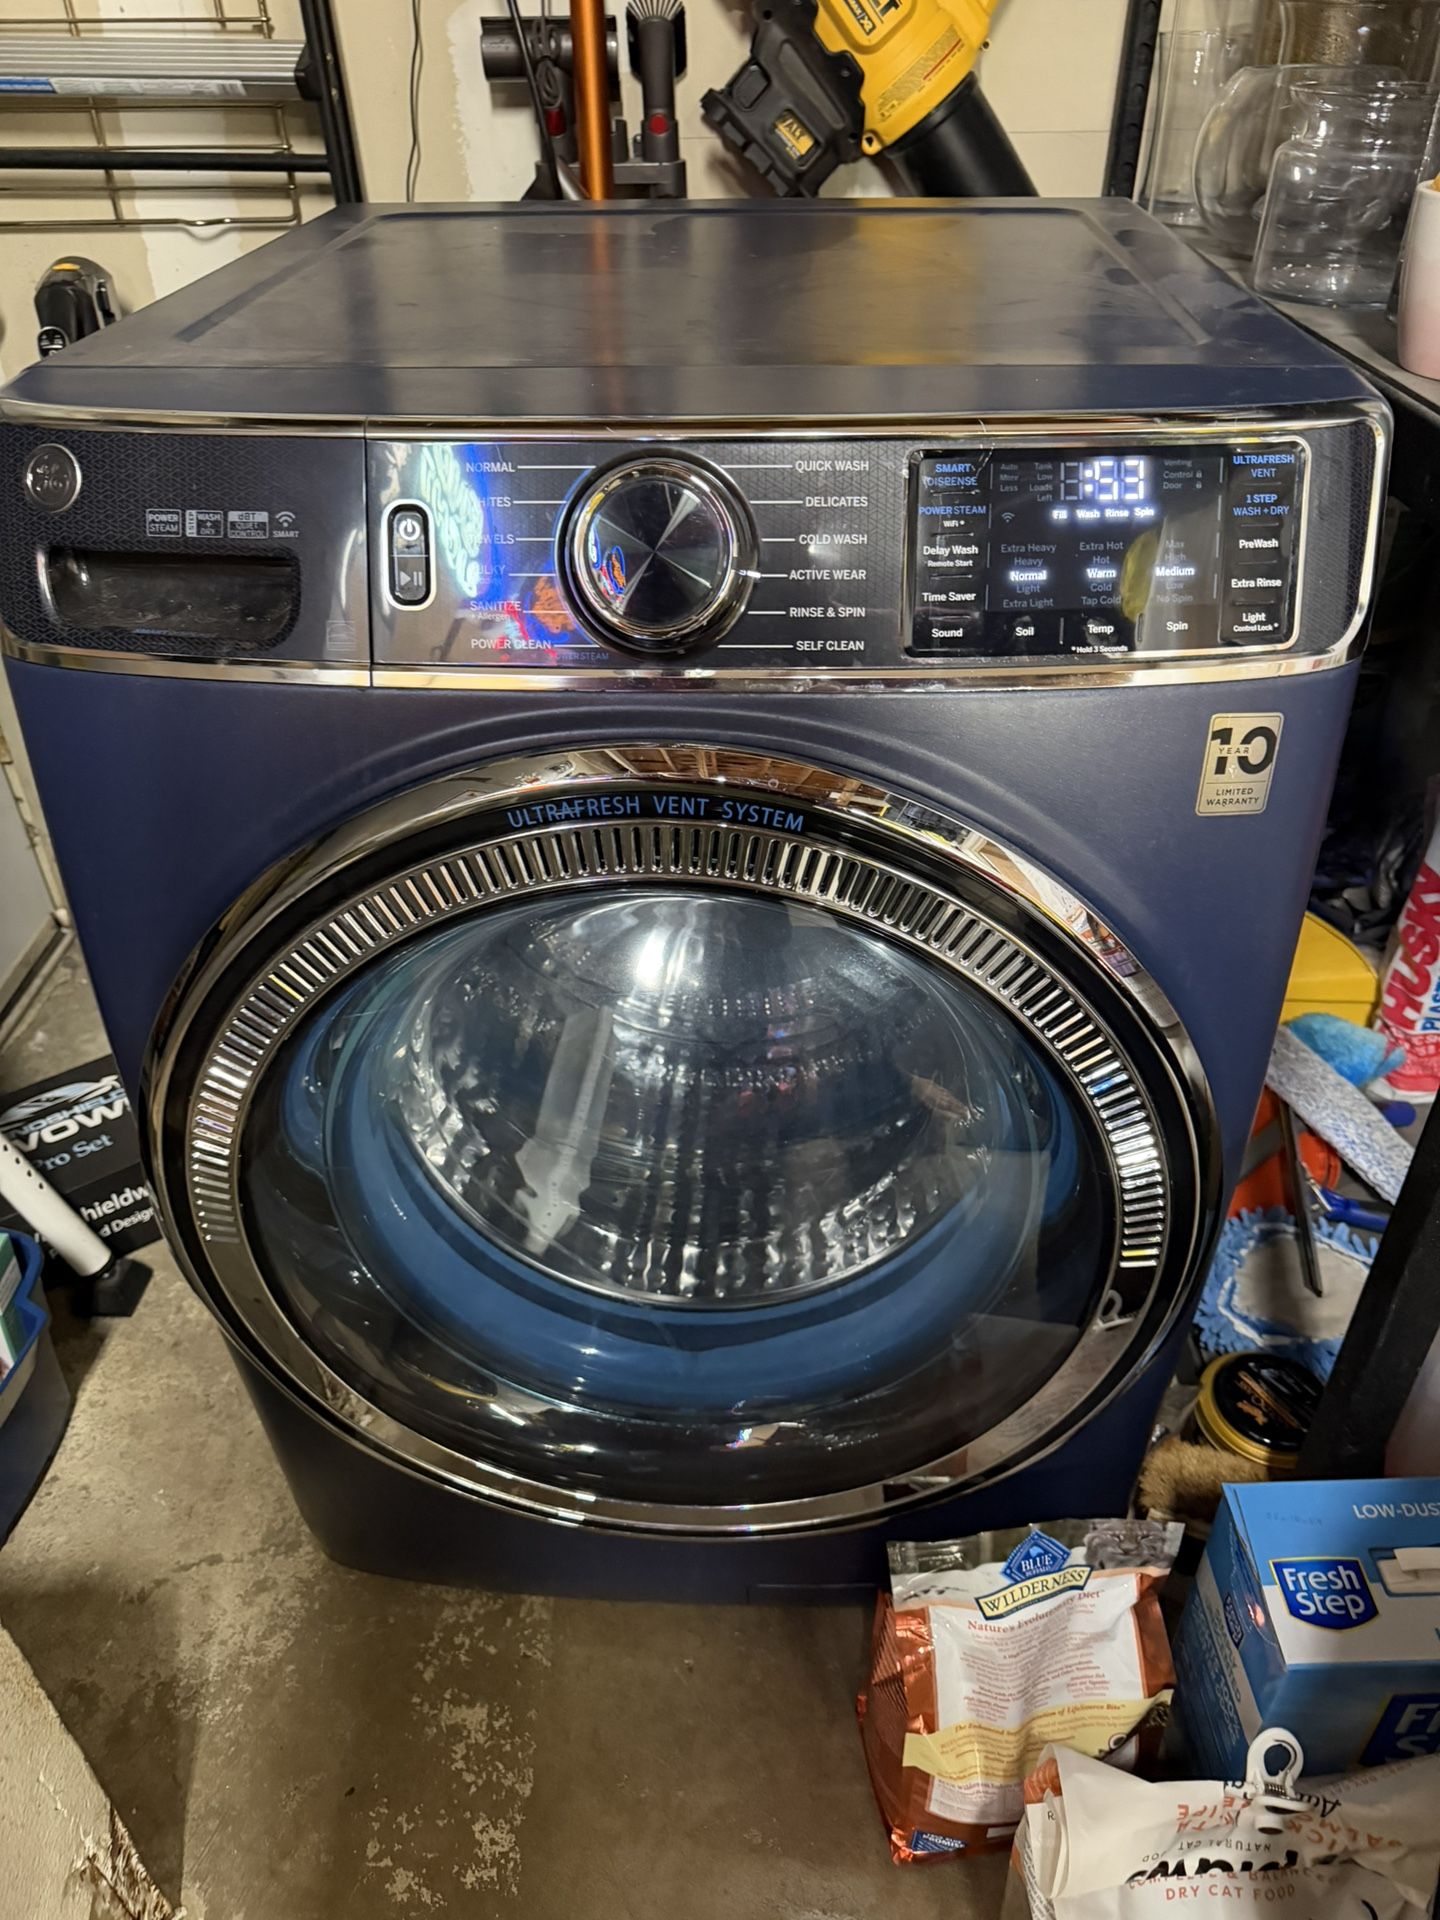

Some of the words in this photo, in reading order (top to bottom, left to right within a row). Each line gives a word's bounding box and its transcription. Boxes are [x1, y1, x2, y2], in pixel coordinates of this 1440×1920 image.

[1233, 454, 1295, 465] ULTRAFRESH
[465, 462, 516, 473] NORMAL
[795, 460, 833, 472] QUICK
[834, 460, 870, 472] WASH
[935, 463, 971, 473] SMART
[1037, 473, 1053, 481] Low
[1163, 470, 1193, 479] Control
[1250, 468, 1277, 478] VENT
[927, 476, 978, 486] DISPENSE
[1162, 481, 1183, 489] Door
[999, 484, 1019, 492] Less
[805, 496, 869, 508] DELICATES
[1246, 495, 1251, 503] 1
[1252, 494, 1278, 504] STEP
[1076, 509, 1100, 519] Wash
[1105, 509, 1129, 518] Rinse
[1134, 508, 1155, 519] Spin
[1233, 507, 1261, 516] WASH
[1270, 506, 1290, 516] DRY
[148, 514, 179, 523] POWER
[149, 523, 178, 532] STEAM
[798, 534, 832, 545] COLD
[833, 534, 868, 545] WASH
[1239, 539, 1279, 549] PreWash
[923, 545, 950, 557] Delay
[952, 544, 979, 555] Wash
[1000, 543, 1027, 553] Extra
[1028, 543, 1057, 554] Heavy
[1079, 541, 1104, 551] Extra
[1106, 541, 1124, 550] Hot
[927, 559, 954, 567] Remote
[955, 559, 973, 567] Start
[1014, 557, 1044, 567] Heavy
[1093, 555, 1110, 565] Hot
[789, 569, 831, 580] ACTIVE
[832, 569, 866, 580] WEAR
[1009, 571, 1048, 582] Normal
[1087, 567, 1117, 579] Warm
[1156, 566, 1195, 577] Medium
[1090, 583, 1113, 592] Cold
[1231, 578, 1255, 588] Extra
[1256, 577, 1282, 587] Rinse
[1016, 584, 1041, 594] Light
[922, 592, 947, 602] Time
[948, 591, 976, 602] Saver
[1081, 595, 1100, 606] Tap
[1100, 595, 1122, 605] Cold
[469, 600, 522, 612] SANITIZE
[1002, 598, 1028, 609] Extra
[1029, 598, 1054, 609] Light
[789, 607, 825, 618] RINSE
[827, 607, 836, 618] &
[838, 607, 866, 618] SPIN
[1242, 612, 1266, 623] Light
[1015, 626, 1034, 637] Soil
[1087, 624, 1115, 635] Temp
[1166, 622, 1189, 632] Spin
[1233, 624, 1258, 632] Control
[1258, 624, 1273, 632] Lock
[931, 628, 963, 638] Sound
[471, 638, 512, 650] POWER
[513, 638, 552, 650] CLEAN
[796, 641, 823, 651] SELF
[826, 641, 865, 651] CLEAN
[1099, 645, 1128, 653] Seconds
[551, 651, 609, 661] OWERSTEAM
[1210, 726, 1278, 775] 10
[1218, 747, 1250, 755] YEAR
[1216, 787, 1254, 796] LIMITED
[1206, 796, 1260, 807] WARRANTY
[507, 795, 641, 829] ULTRAFRESH
[651, 795, 710, 817] VENT
[722, 801, 804, 832] SYSTEM
[71, 1133, 114, 1159] Set
[1021, 1553, 1053, 1572] BLUE
[1281, 1565, 1362, 1592] Fresh
[983, 1569, 1086, 1612] WILDERNESS
[1297, 1591, 1366, 1620] Step
[1178, 1839, 1203, 1851] CAT
[1208, 1838, 1272, 1852] NATURAL
[1165, 1884, 1200, 1901] DRY
[1208, 1884, 1244, 1899] CAT
[1253, 1884, 1296, 1901] FOOD
